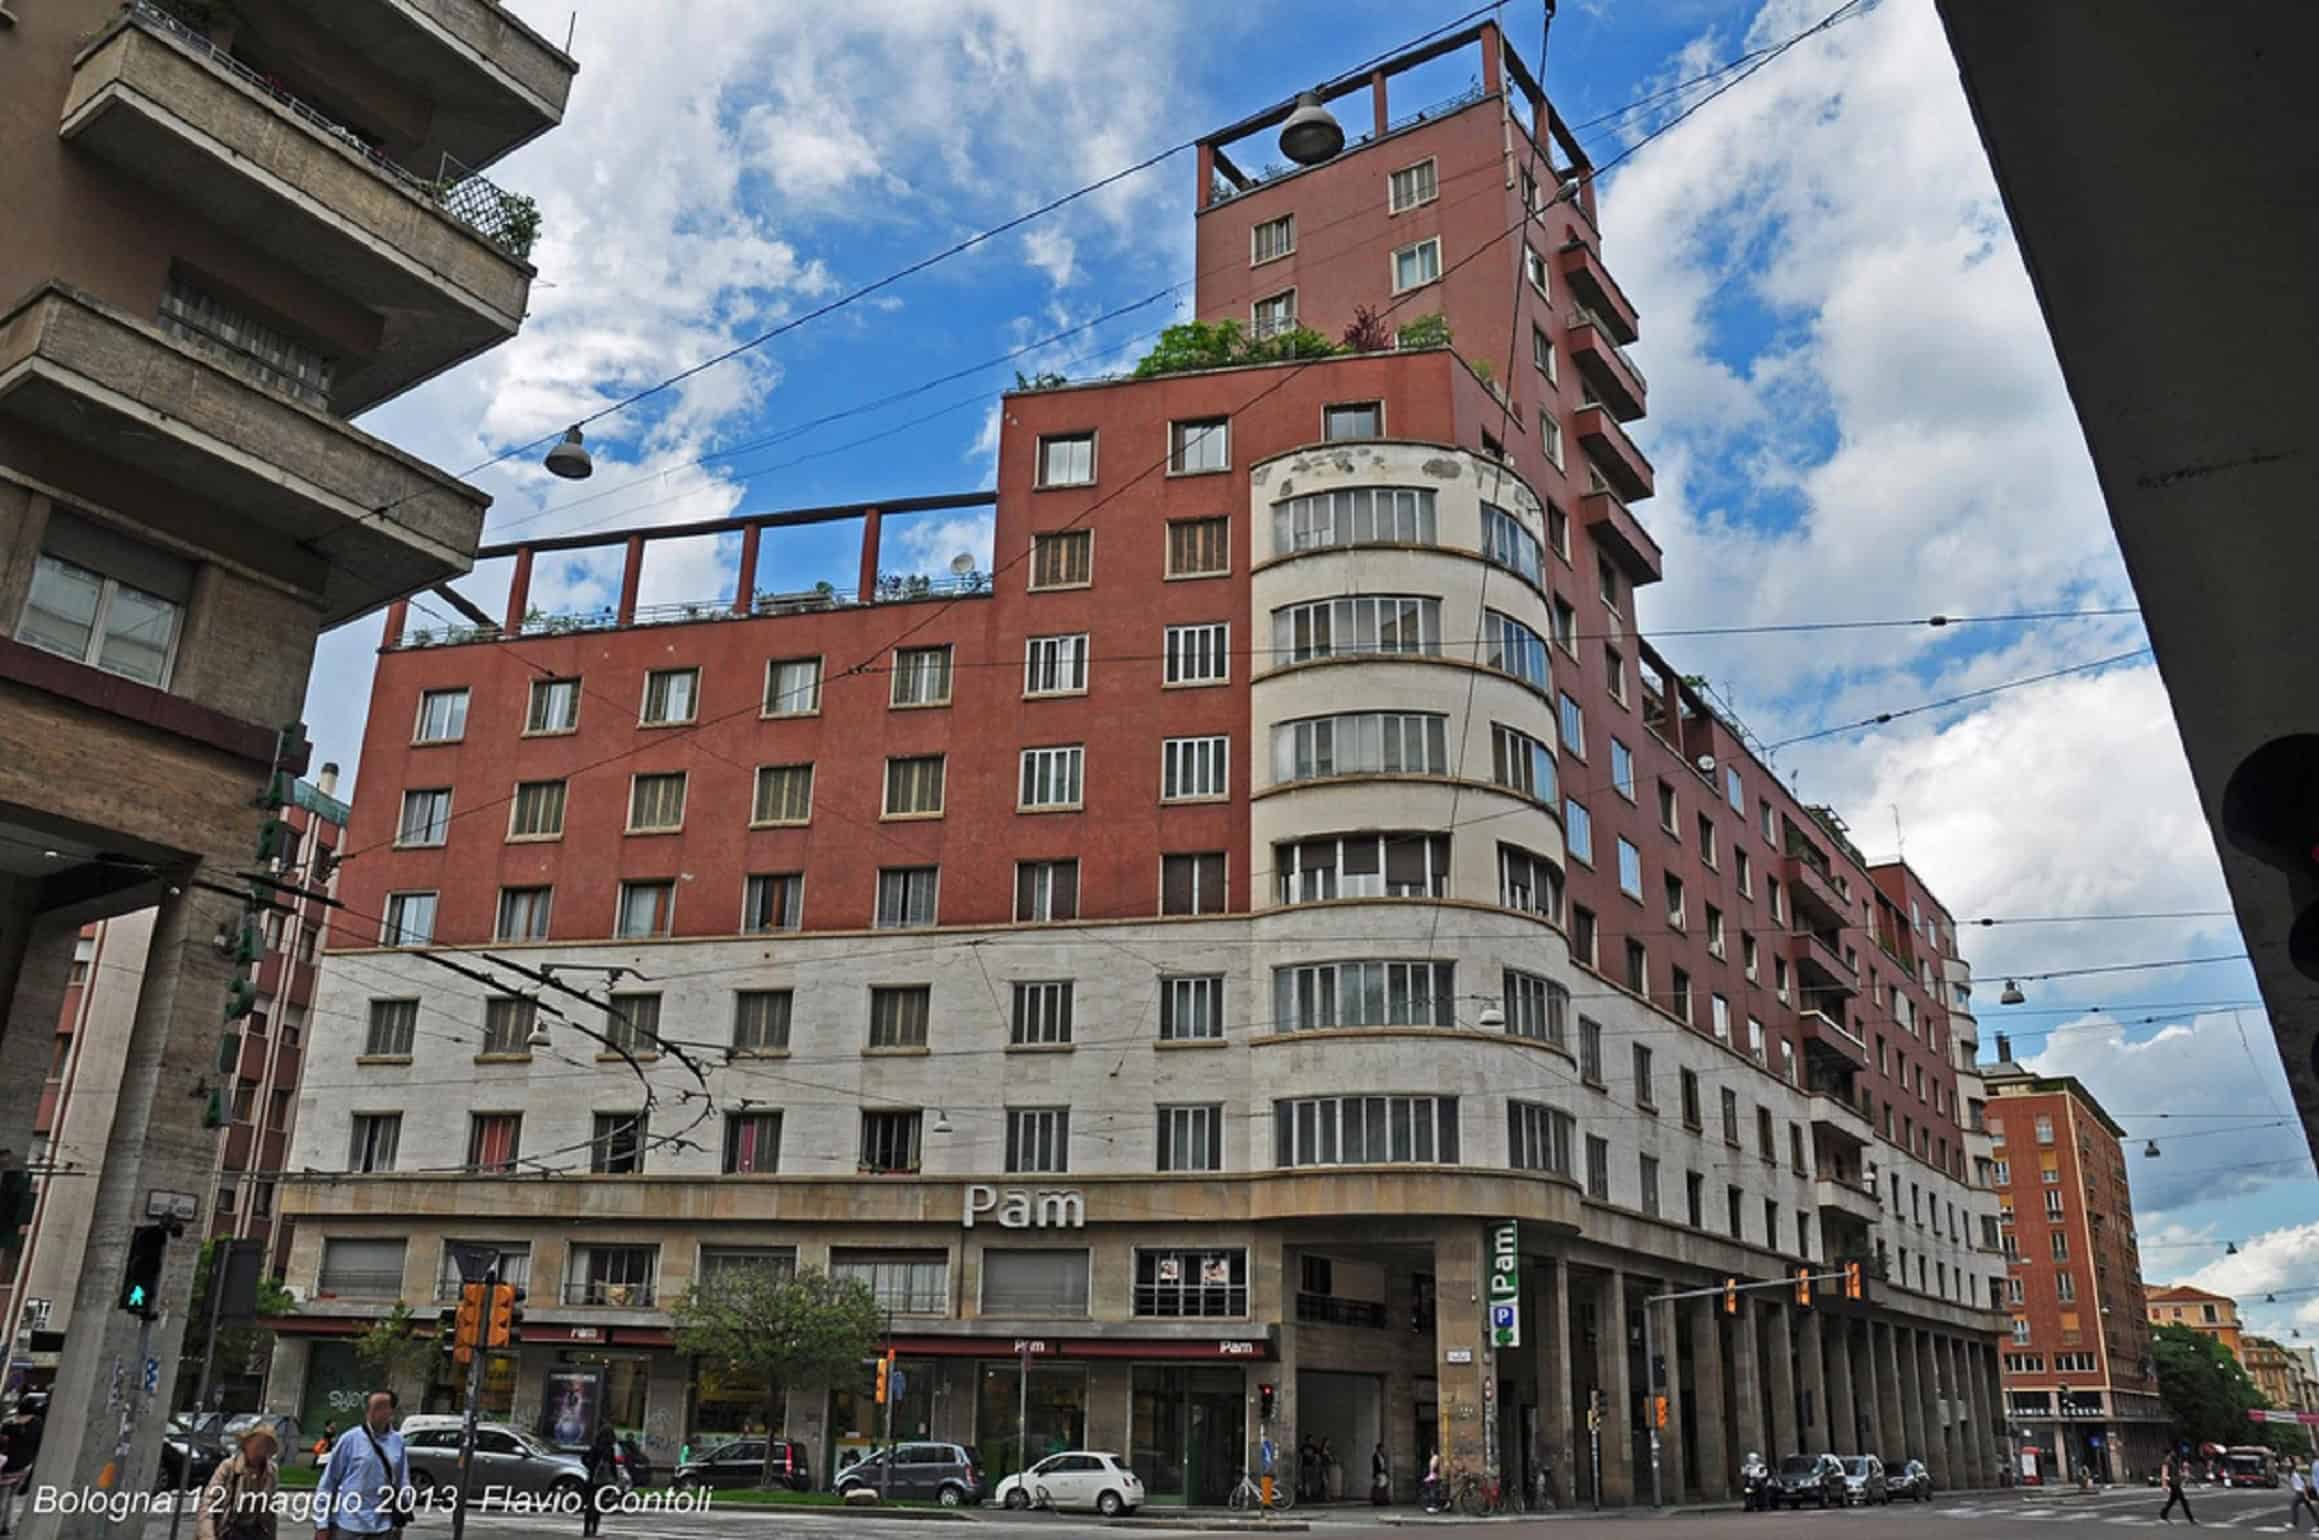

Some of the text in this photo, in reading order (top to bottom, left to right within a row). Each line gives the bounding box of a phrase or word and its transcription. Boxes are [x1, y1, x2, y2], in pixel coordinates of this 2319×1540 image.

[962, 1184, 1085, 1228] Pam
[1491, 1226, 1515, 1294] Pam
[1498, 1309, 1509, 1323] P
[1014, 1339, 1045, 1353] Pm
[1220, 1340, 1253, 1353] Pam
